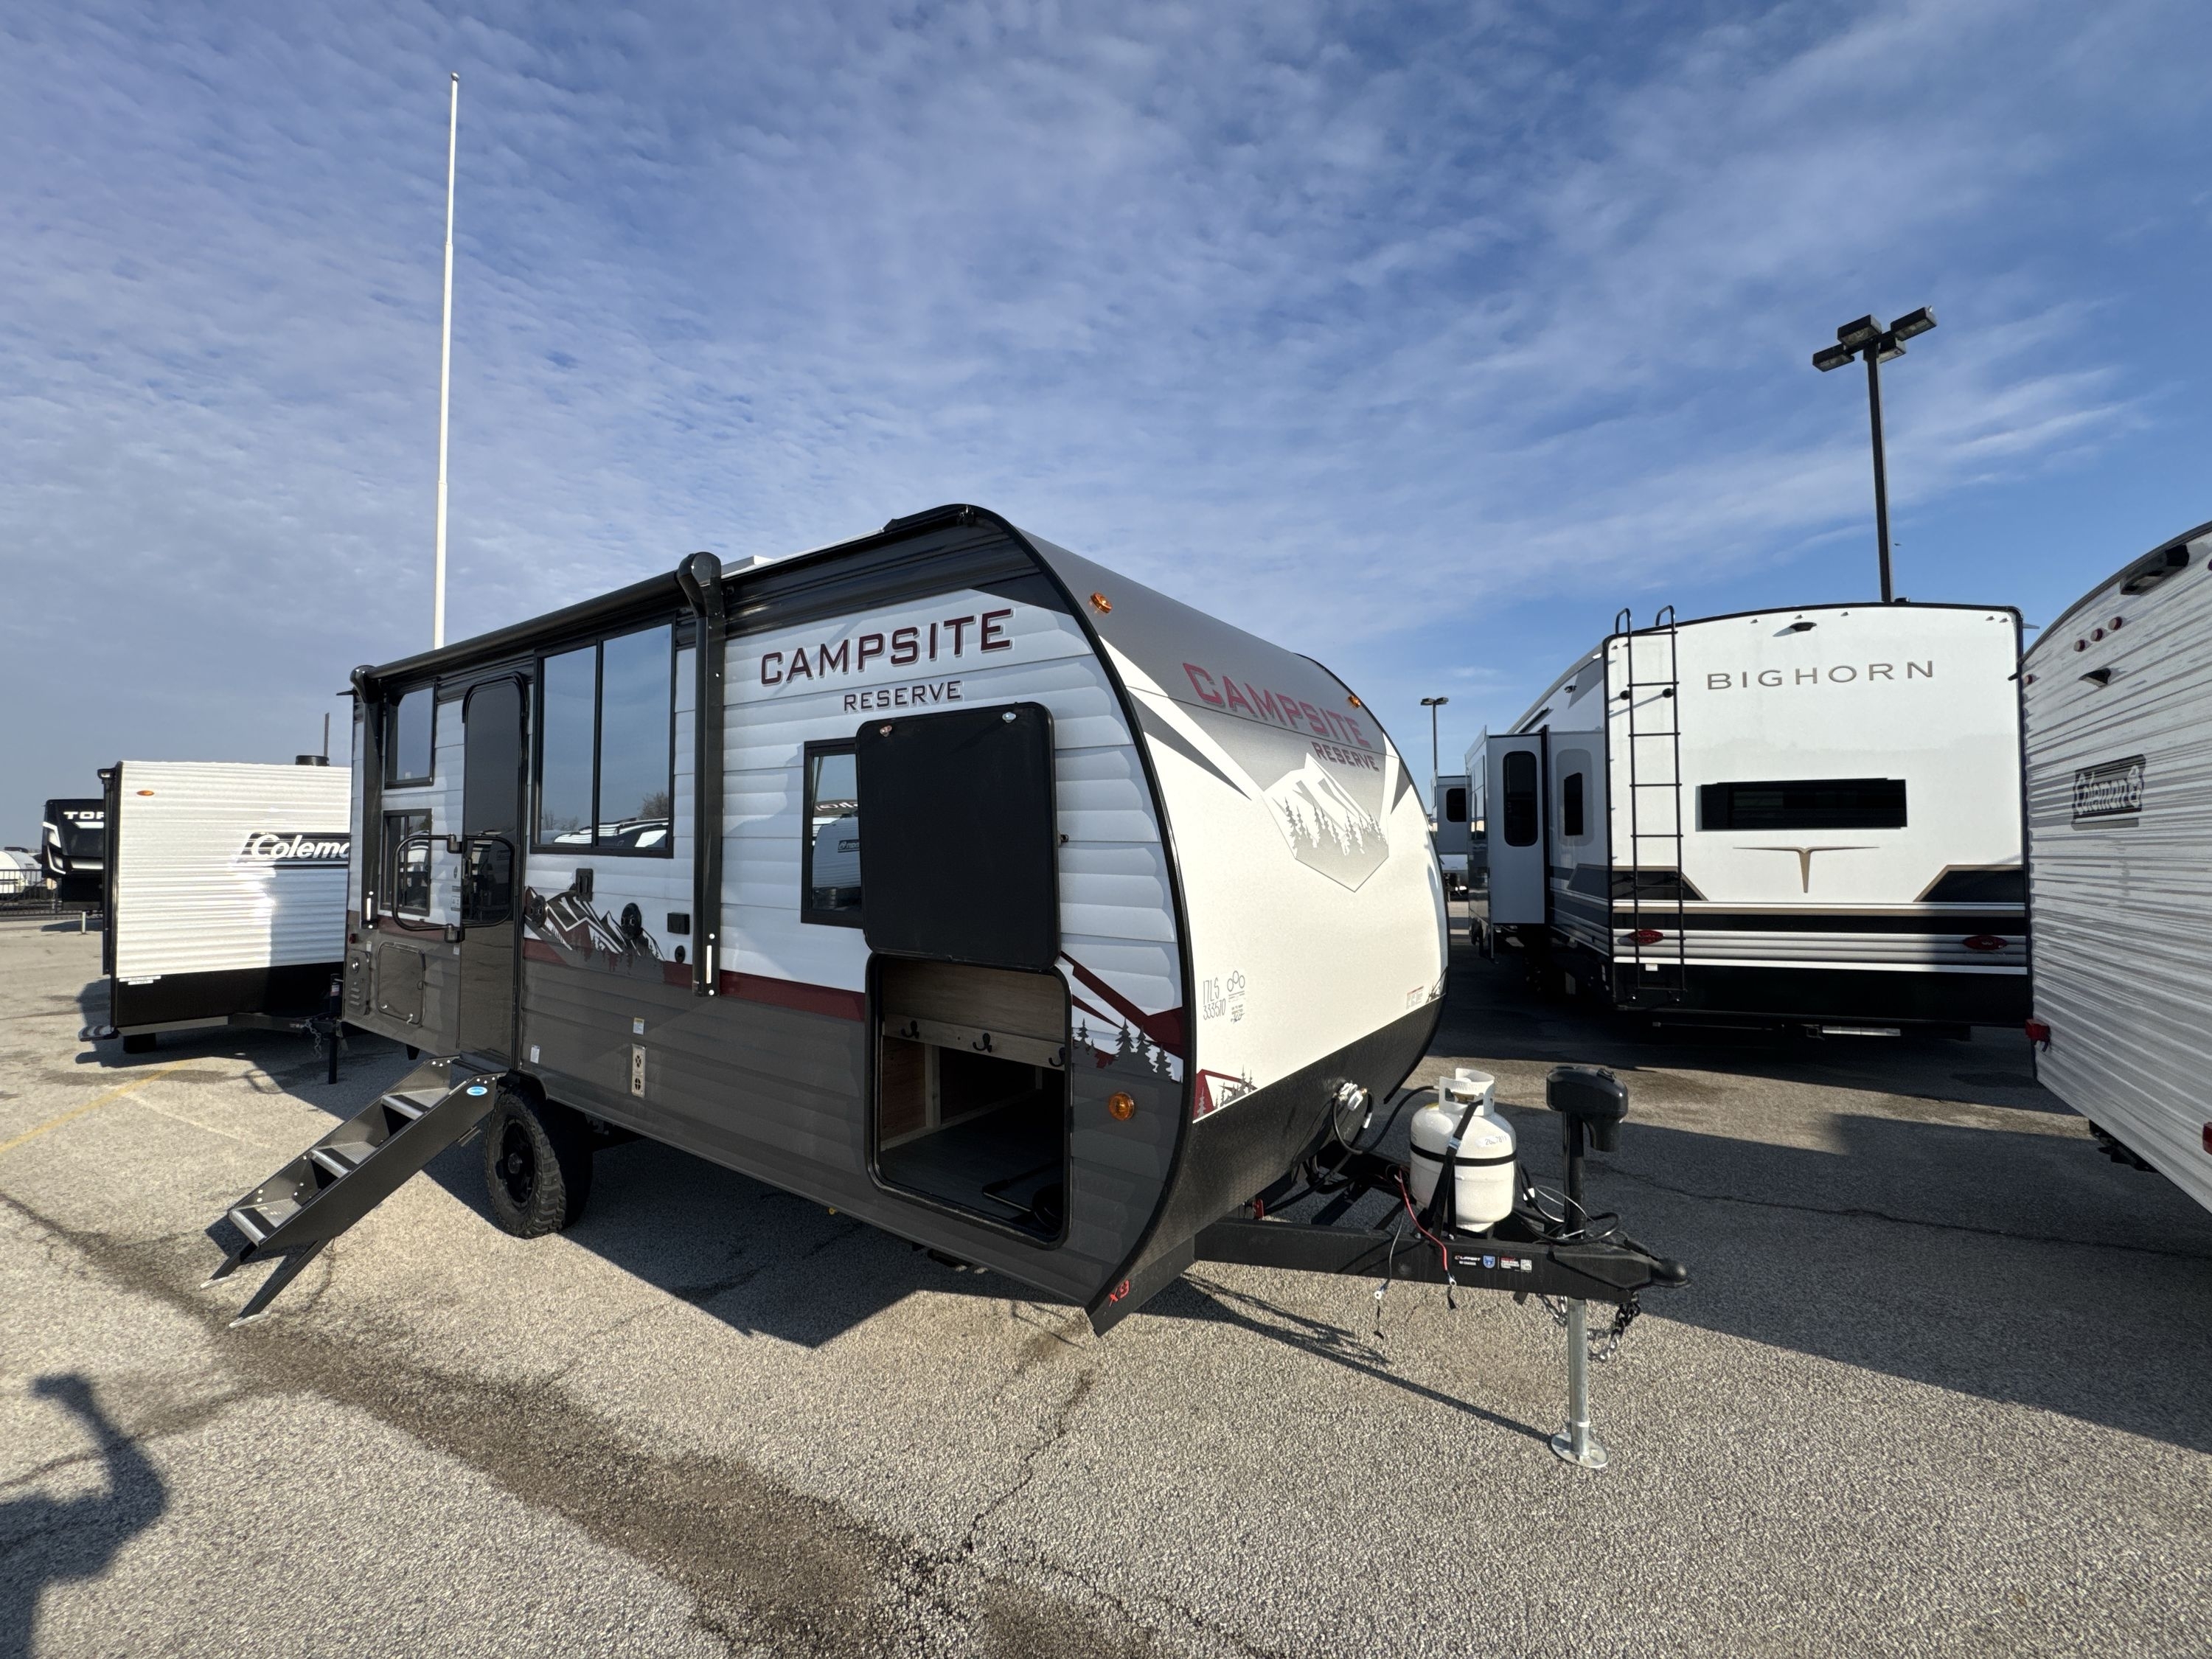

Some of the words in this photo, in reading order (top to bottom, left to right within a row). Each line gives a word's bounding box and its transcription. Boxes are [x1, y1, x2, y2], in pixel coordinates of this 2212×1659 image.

[761, 608, 1013, 686] CAMPSITE
[1707, 661, 1933, 689] BIGHORN
[844, 681, 962, 712] RESERVE
[1183, 662, 1373, 749] CAMPSITE
[1311, 741, 1380, 772] RESERVE
[2073, 772, 2127, 815] Coleman
